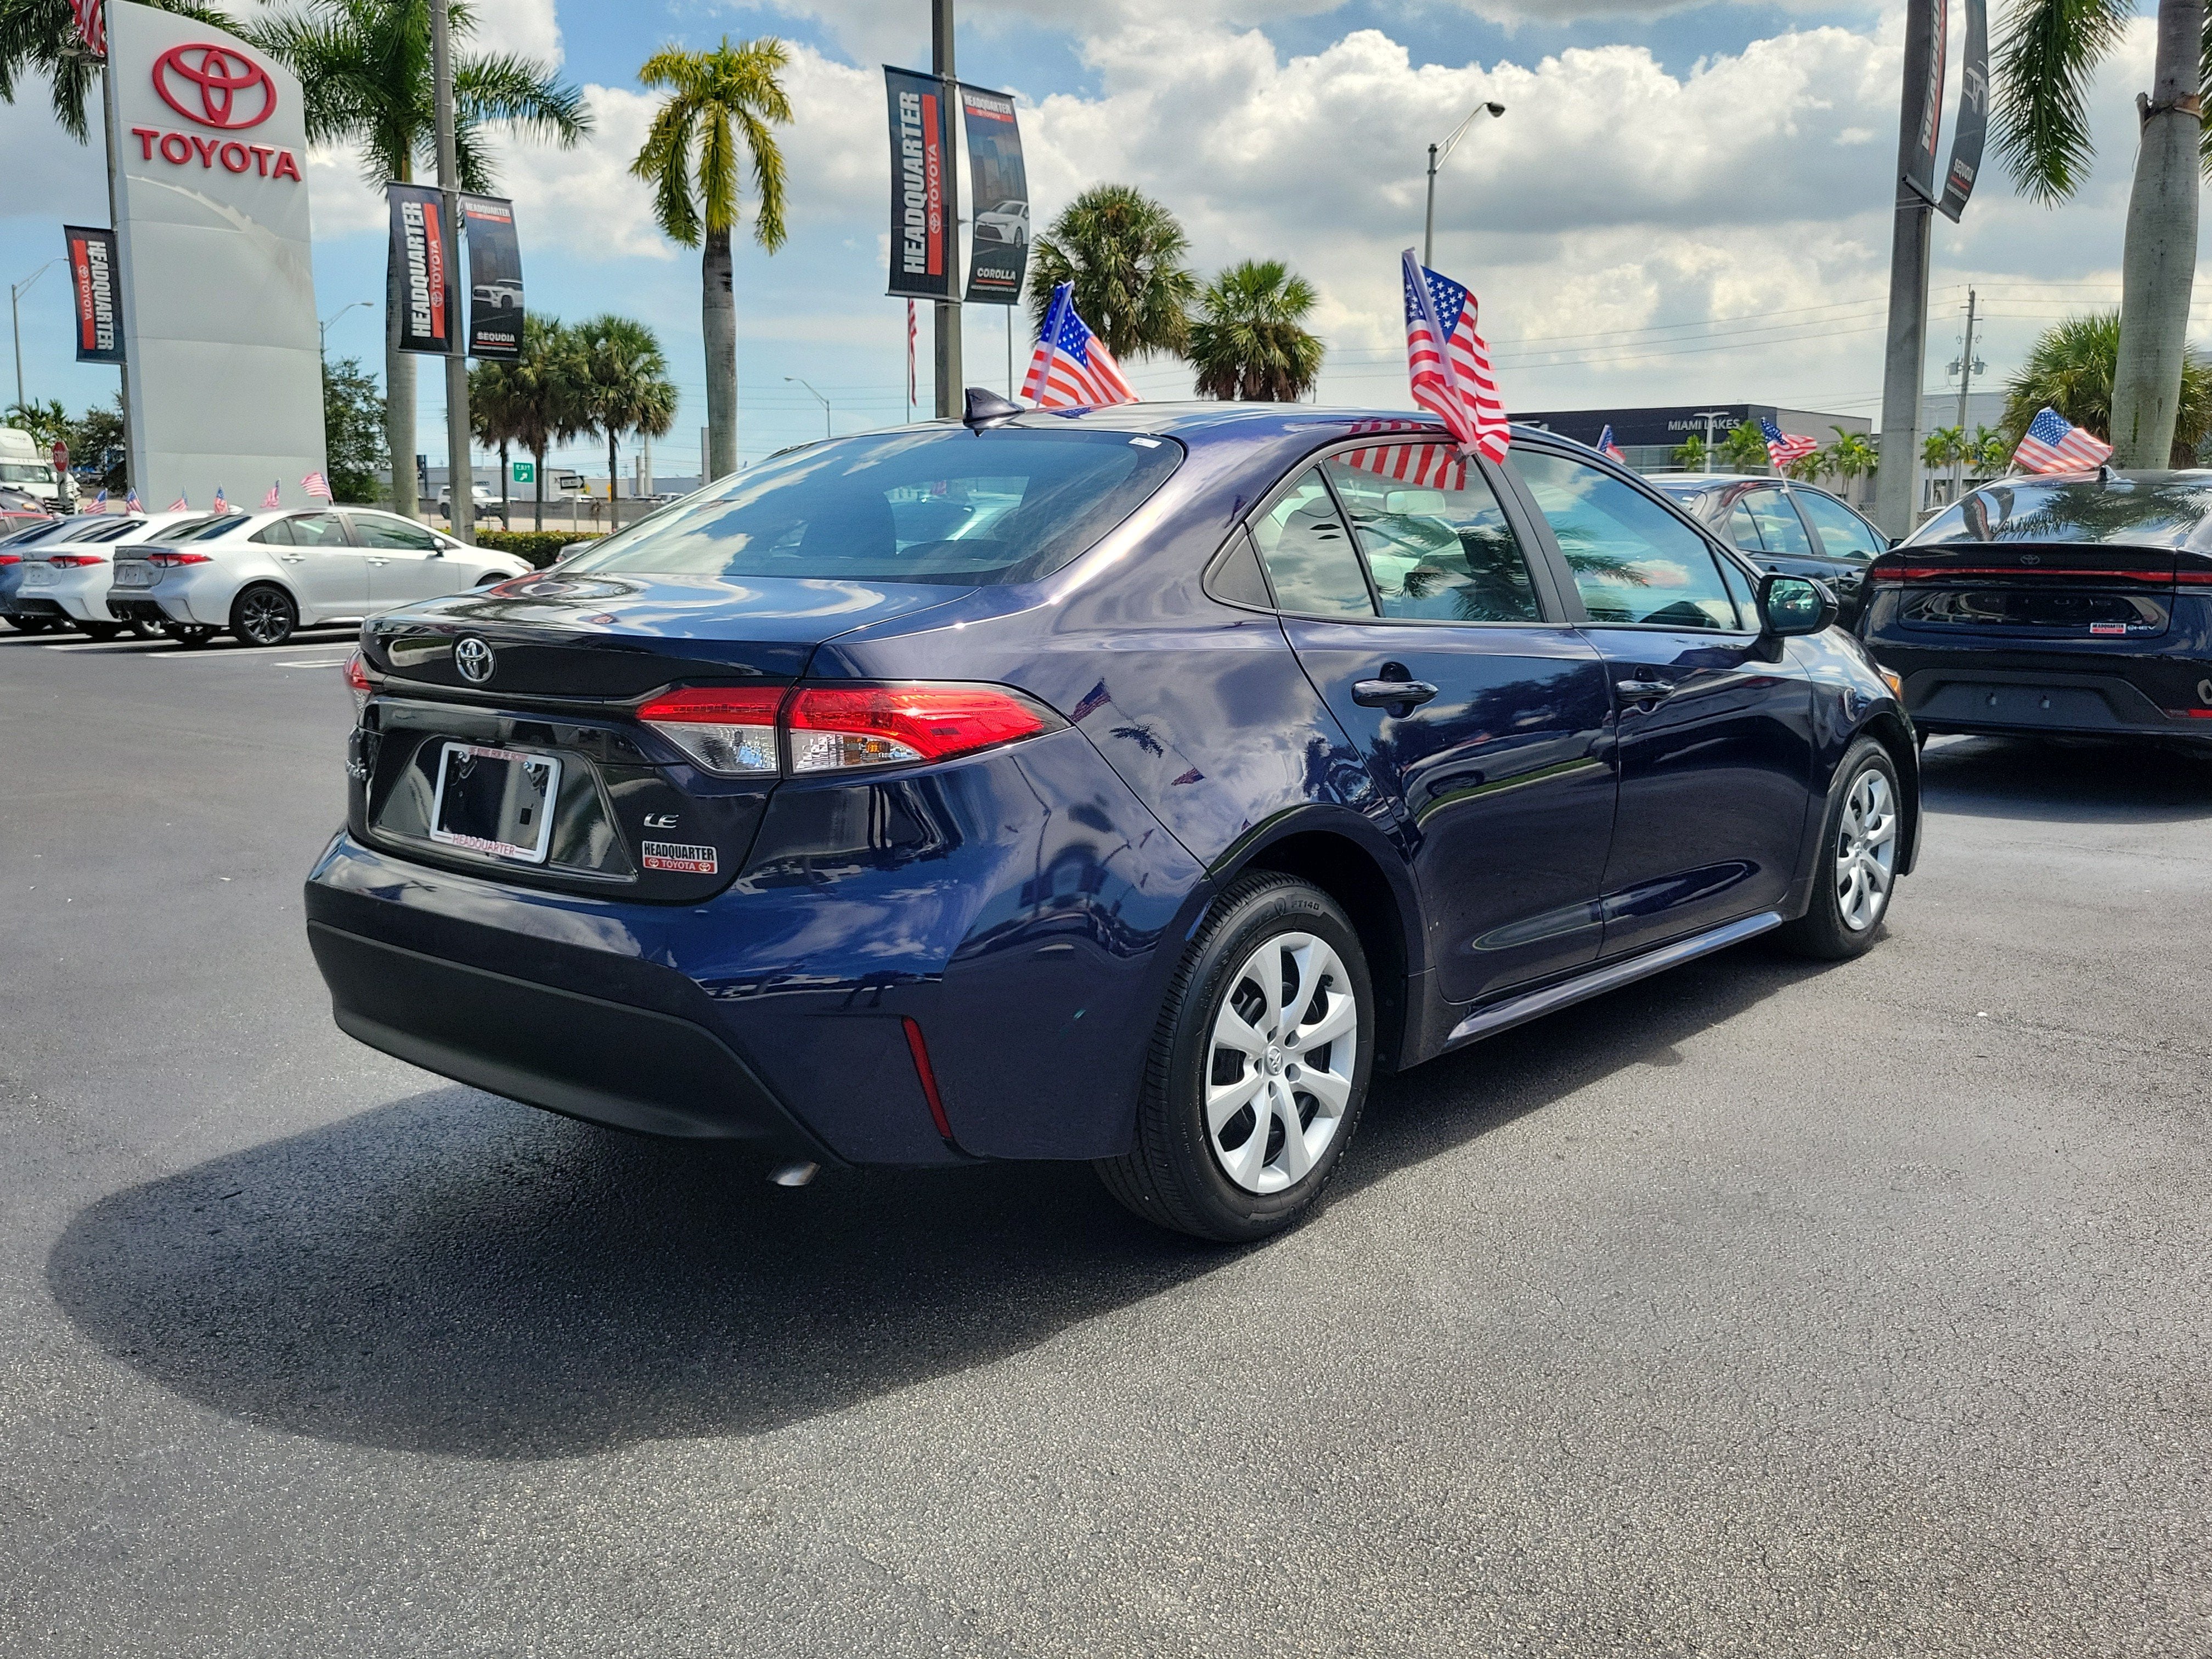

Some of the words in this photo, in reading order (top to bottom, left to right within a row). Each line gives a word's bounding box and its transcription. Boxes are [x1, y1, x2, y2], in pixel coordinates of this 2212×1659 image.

[132, 128, 301, 182] TOYOTA
[899, 91, 928, 274] HEADQUARTER
[928, 143, 939, 211] TOYOTA
[402, 201, 432, 338] HEADQUARTER
[431, 239, 442, 289] TOYOTA
[977, 267, 1016, 280] COROLLA
[81, 279, 93, 320] TOYOTA
[87, 240, 115, 351] HEADQUARTER
[476, 331, 516, 342] SEQUOIA
[1668, 420, 1701, 431] MIAMI
[644, 813, 679, 828] LE
[452, 833, 515, 856] HEADQUARTER
[644, 842, 715, 861] HEADQUARTER
[661, 860, 696, 871] TOYOTA
